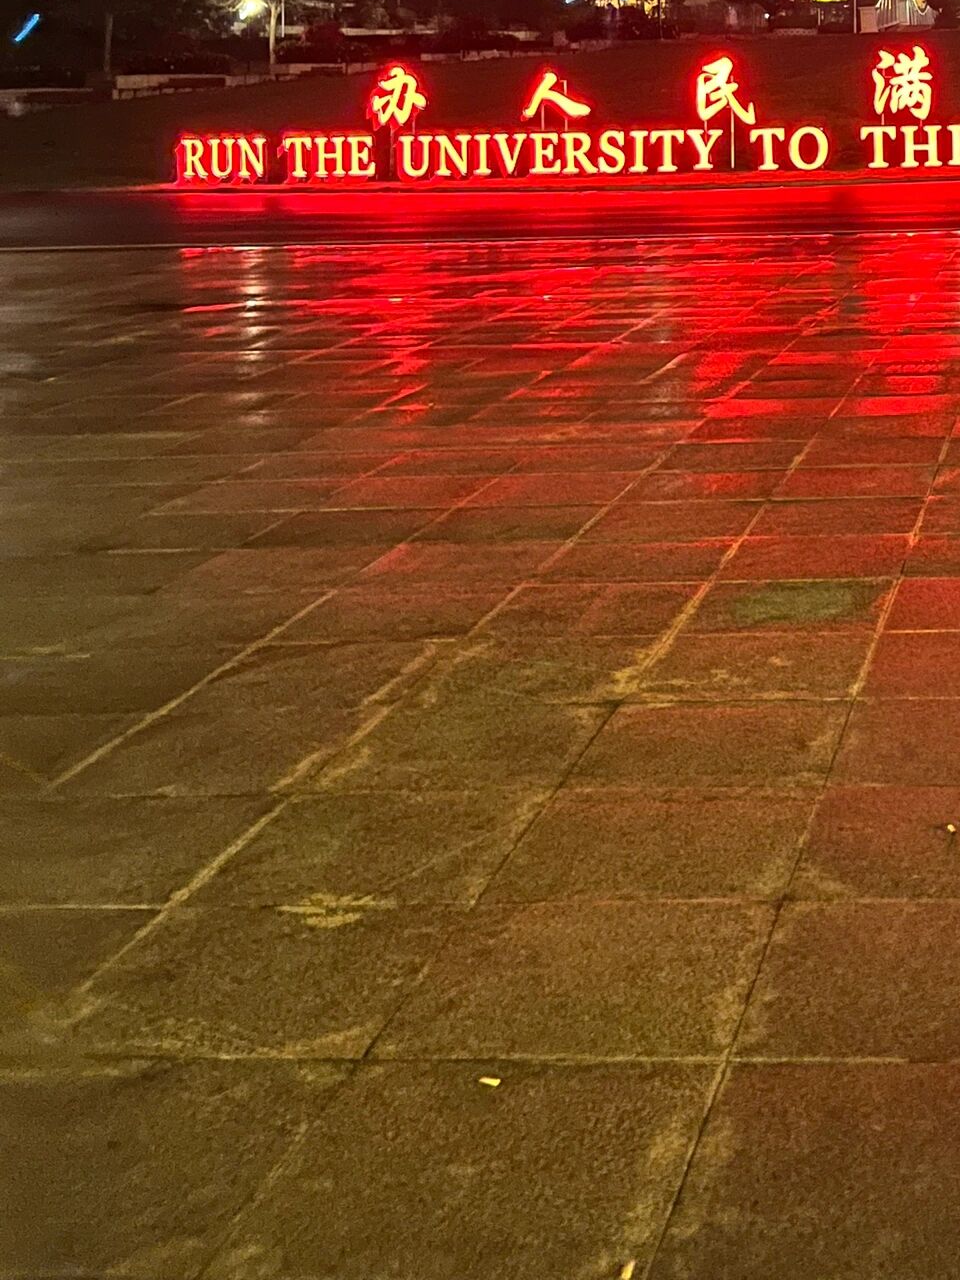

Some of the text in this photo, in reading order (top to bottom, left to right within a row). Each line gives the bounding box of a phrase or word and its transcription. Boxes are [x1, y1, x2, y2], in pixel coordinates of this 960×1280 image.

[180, 137, 267, 179] RUN
[281, 136, 377, 179] THE
[398, 127, 724, 178] UNIVERSITY
[749, 126, 829, 171] TO
